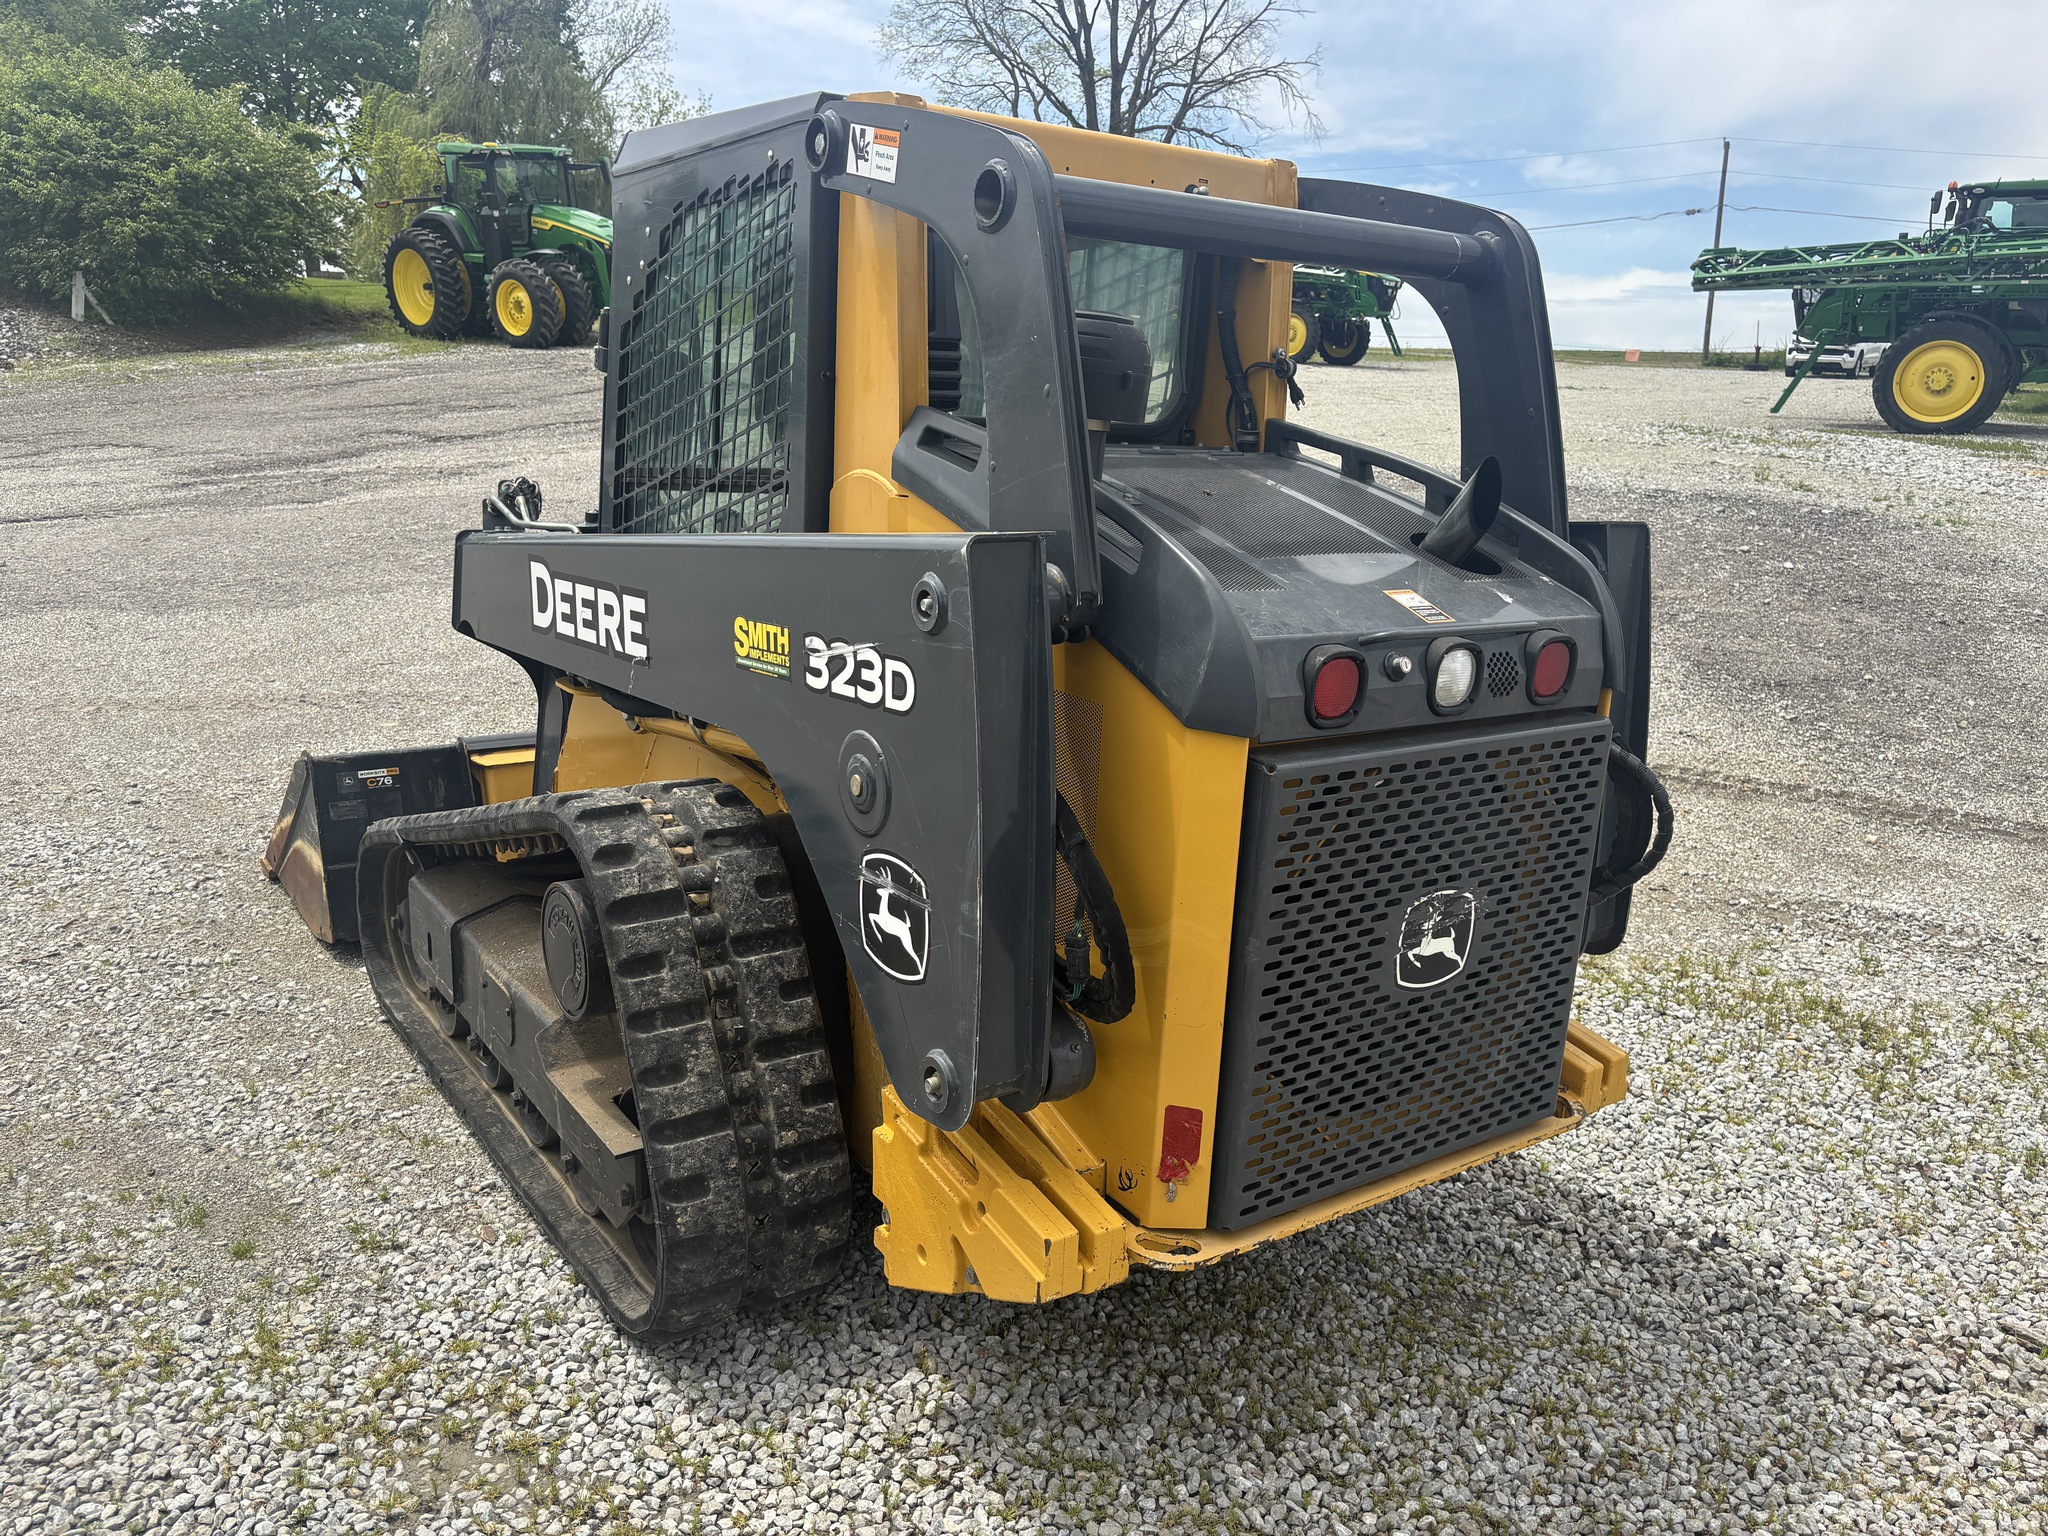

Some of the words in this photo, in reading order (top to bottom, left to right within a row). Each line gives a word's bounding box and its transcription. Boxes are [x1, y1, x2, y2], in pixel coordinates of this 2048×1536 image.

[529, 561, 647, 658] DEERE
[734, 616, 790, 657] SMITH
[749, 648, 790, 668] IMPLEMENTS
[804, 635, 916, 713] 323D
[367, 776, 393, 787] C76
